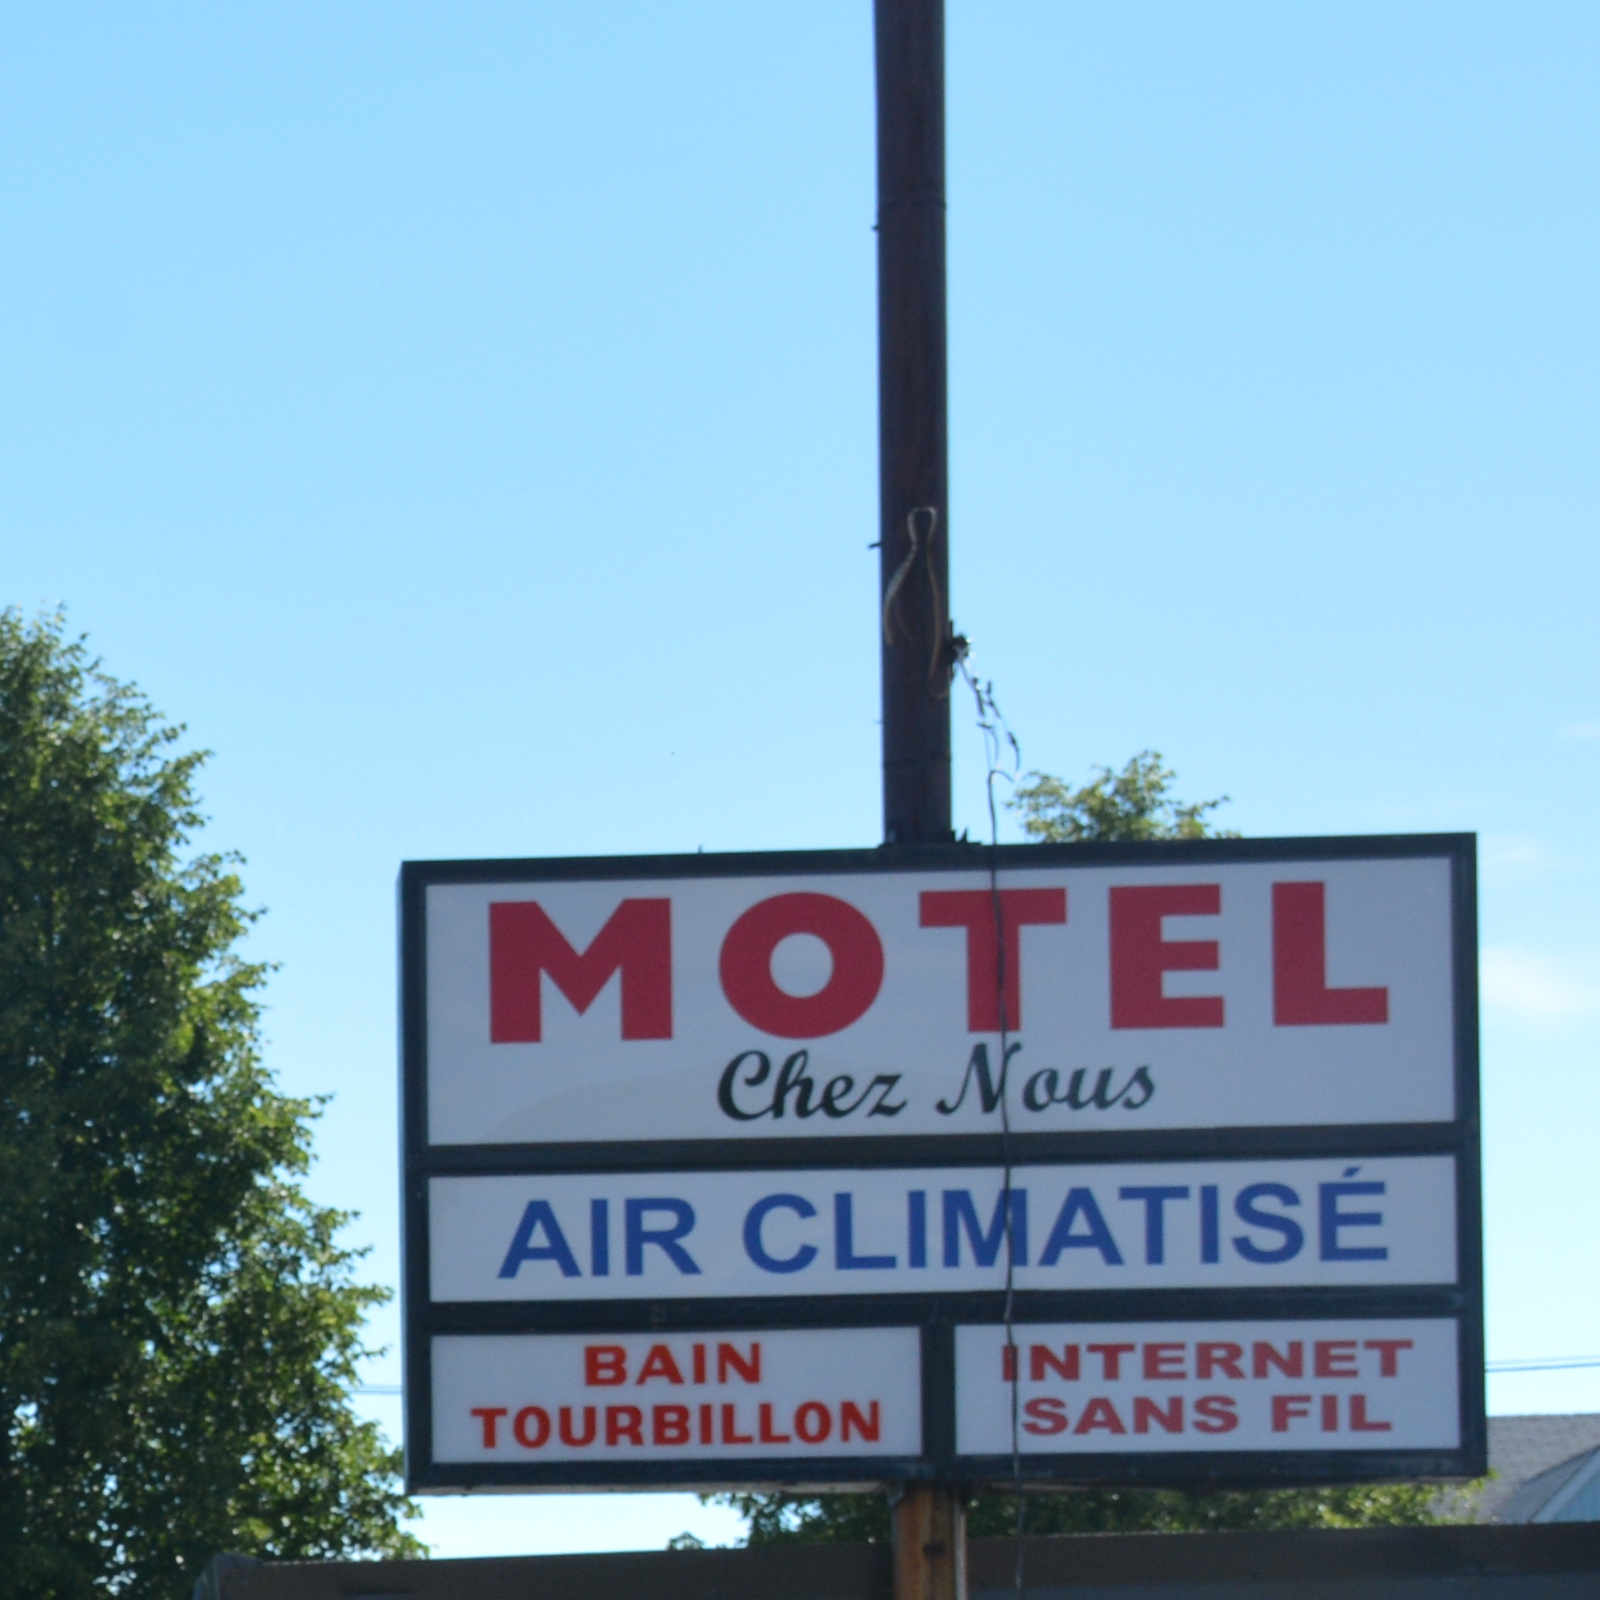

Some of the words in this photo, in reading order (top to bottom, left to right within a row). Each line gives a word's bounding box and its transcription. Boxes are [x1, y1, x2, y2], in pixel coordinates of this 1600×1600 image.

[490, 882, 1390, 1043] MOTEL
[717, 1050, 906, 1121] Chez
[935, 1042, 1156, 1115] Nous
[497, 1195, 704, 1280] AIR
[741, 1167, 1391, 1276] CLIMATISÉ
[584, 1342, 762, 1386] BAIN
[1002, 1338, 1415, 1383] INTERNET
[471, 1400, 882, 1449] TOURBILLON
[1022, 1393, 1241, 1437] SANS
[1270, 1392, 1394, 1434] FIL
